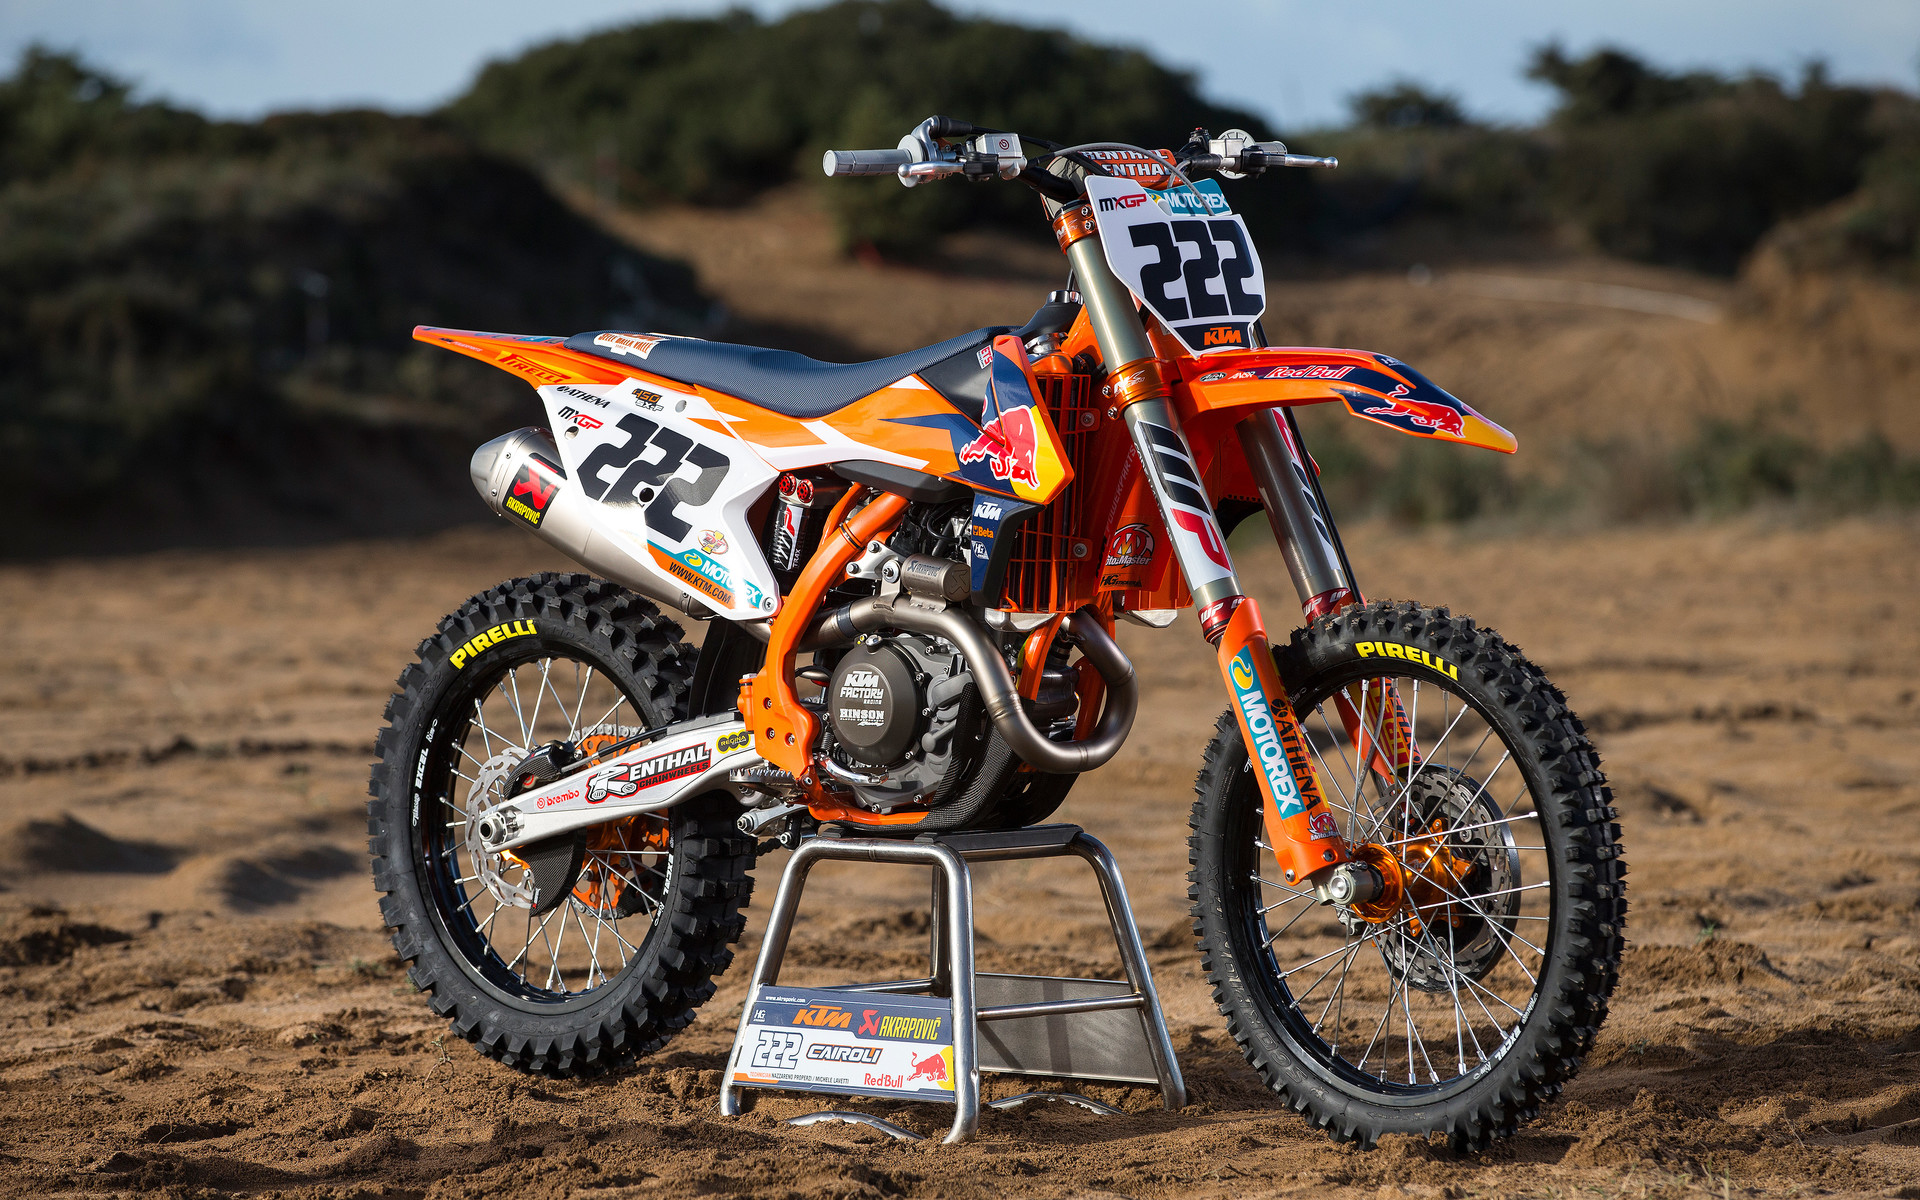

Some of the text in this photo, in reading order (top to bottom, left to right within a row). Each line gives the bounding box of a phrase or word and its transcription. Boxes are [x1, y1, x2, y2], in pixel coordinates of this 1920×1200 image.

[1099, 193, 1147, 212] MXGP
[1163, 192, 1230, 208] MOTOREX
[1128, 219, 1264, 321] 222
[1203, 326, 1242, 346] KTM
[497, 353, 572, 384] PIRELLI
[567, 387, 611, 409] ATHENA
[632, 389, 661, 403] 450
[558, 406, 604, 429] MXGP
[577, 413, 730, 543] 222
[974, 502, 1002, 520] KTM
[978, 526, 994, 538] Beta
[669, 562, 731, 604] WWW.KTM.COM
[450, 619, 538, 669] PIRELLI
[1355, 641, 1459, 682] PIRELLI
[844, 670, 880, 688] KTM
[840, 686, 884, 699] FACTORY
[840, 708, 885, 719] HINSON
[721, 735, 746, 746] REGINA
[1240, 690, 1301, 815] MOTOREX
[415, 748, 429, 789] EXCEL
[639, 762, 709, 788] CHAINWHEELS
[1276, 717, 1321, 811] ATHENA
[546, 789, 580, 806] brembo
[753, 1009, 766, 1019] HG
[792, 1004, 852, 1029] KTM
[751, 1030, 803, 1070] 222
[805, 1043, 884, 1064] CAIROLI
[1495, 1025, 1521, 1061] EXCEL
